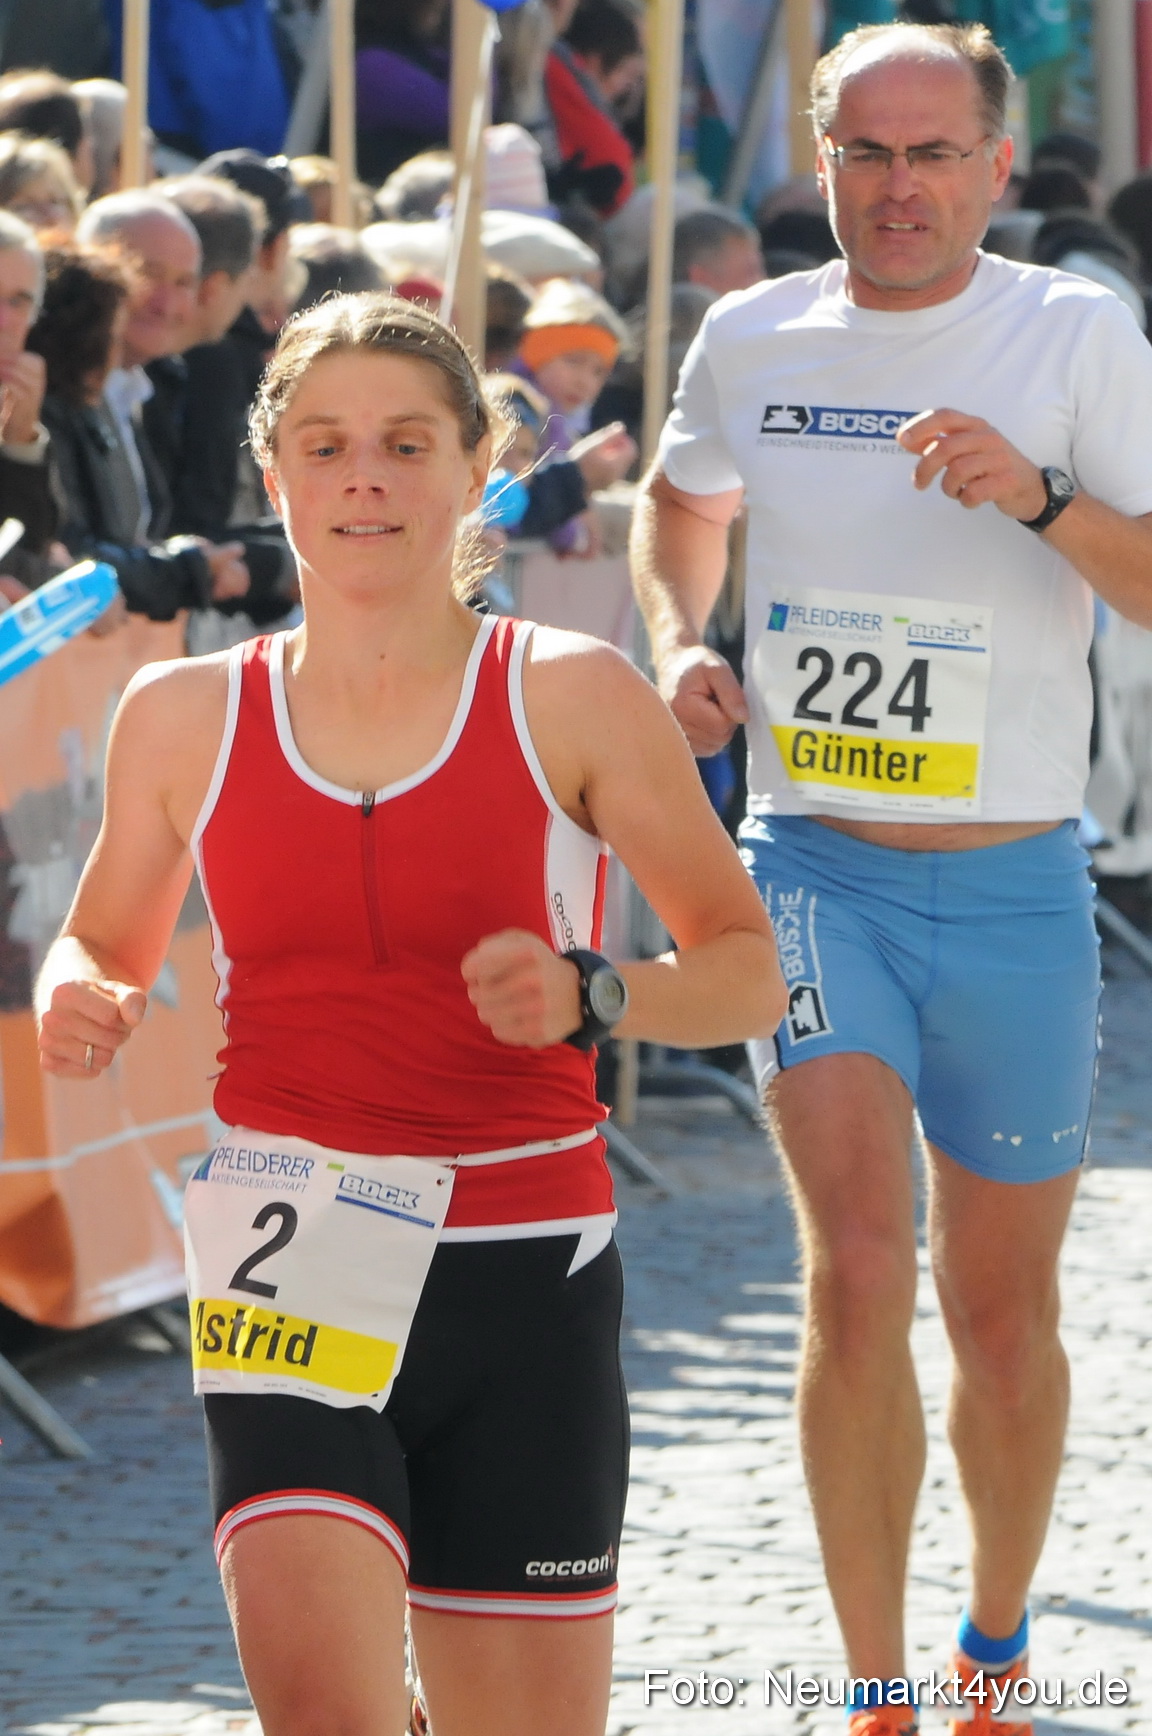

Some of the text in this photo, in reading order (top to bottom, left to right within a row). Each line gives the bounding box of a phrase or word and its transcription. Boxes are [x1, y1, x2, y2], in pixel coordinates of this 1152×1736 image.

[790, 606, 883, 632] PFLEIDERER
[908, 623, 970, 642] BOCK
[793, 646, 932, 732] 224
[791, 730, 927, 783] Günter
[214, 1147, 315, 1179] PFLEIDERER
[339, 1174, 420, 1209] BOCK
[228, 1201, 298, 1300] 2
[525, 1554, 609, 1577] cocoon
